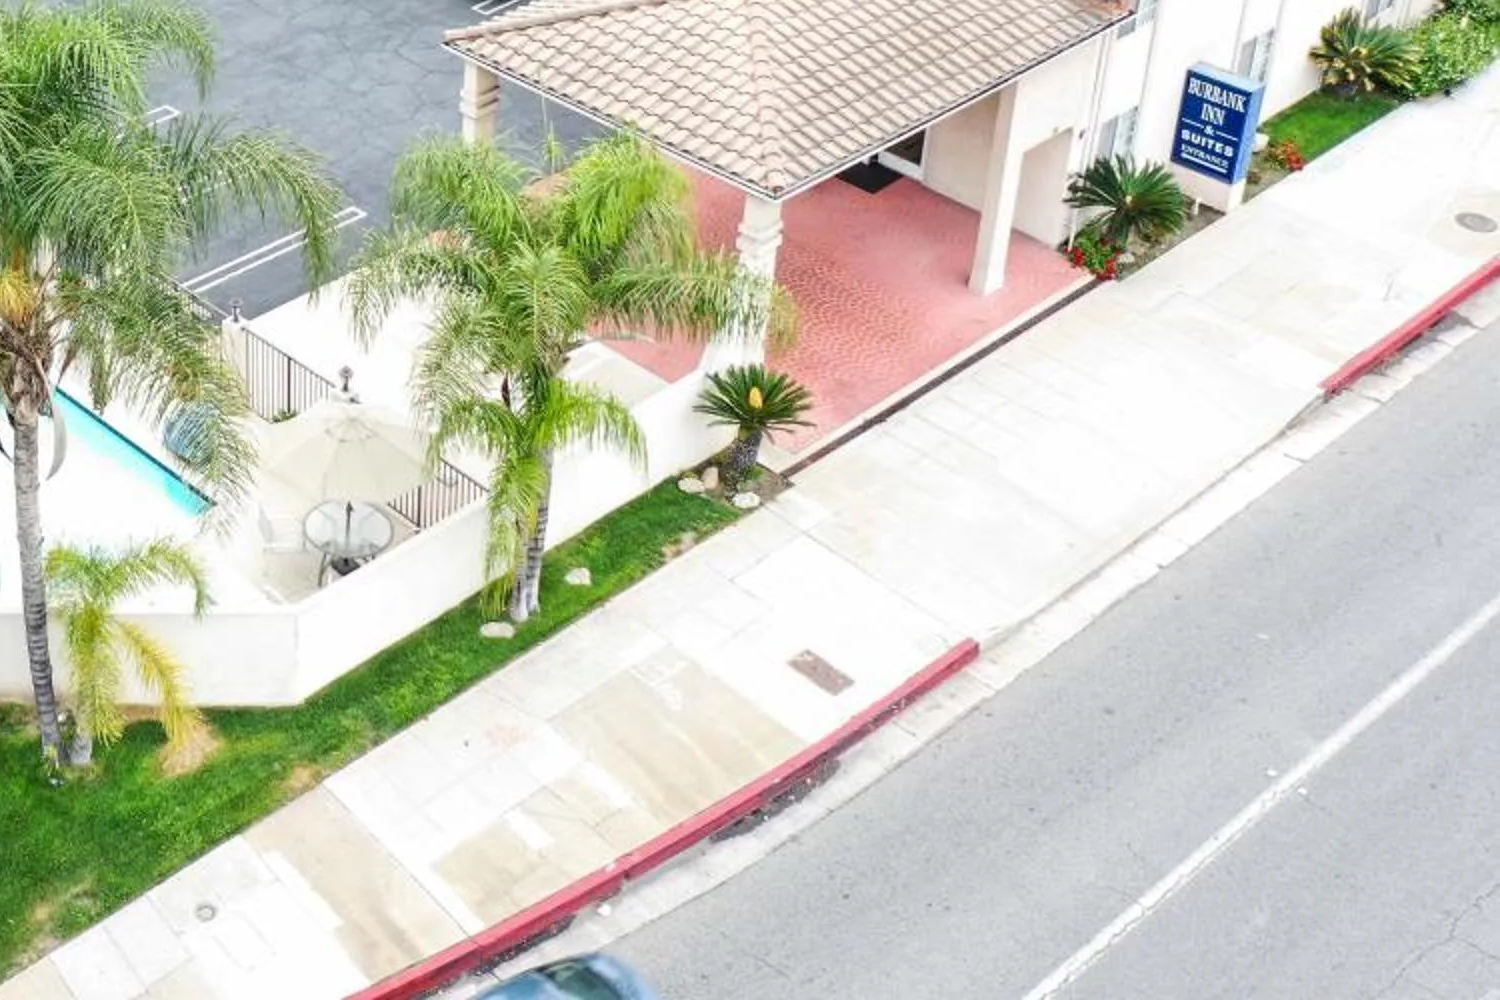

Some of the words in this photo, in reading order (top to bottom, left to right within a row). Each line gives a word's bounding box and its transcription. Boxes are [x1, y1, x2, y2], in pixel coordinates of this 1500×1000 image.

[1187, 77, 1247, 113] BURBANK
[1201, 103, 1226, 126] INN
[1181, 129, 1234, 157] SUITES
[1204, 125, 1215, 136] &
[1181, 143, 1229, 169] ENTRANCE
